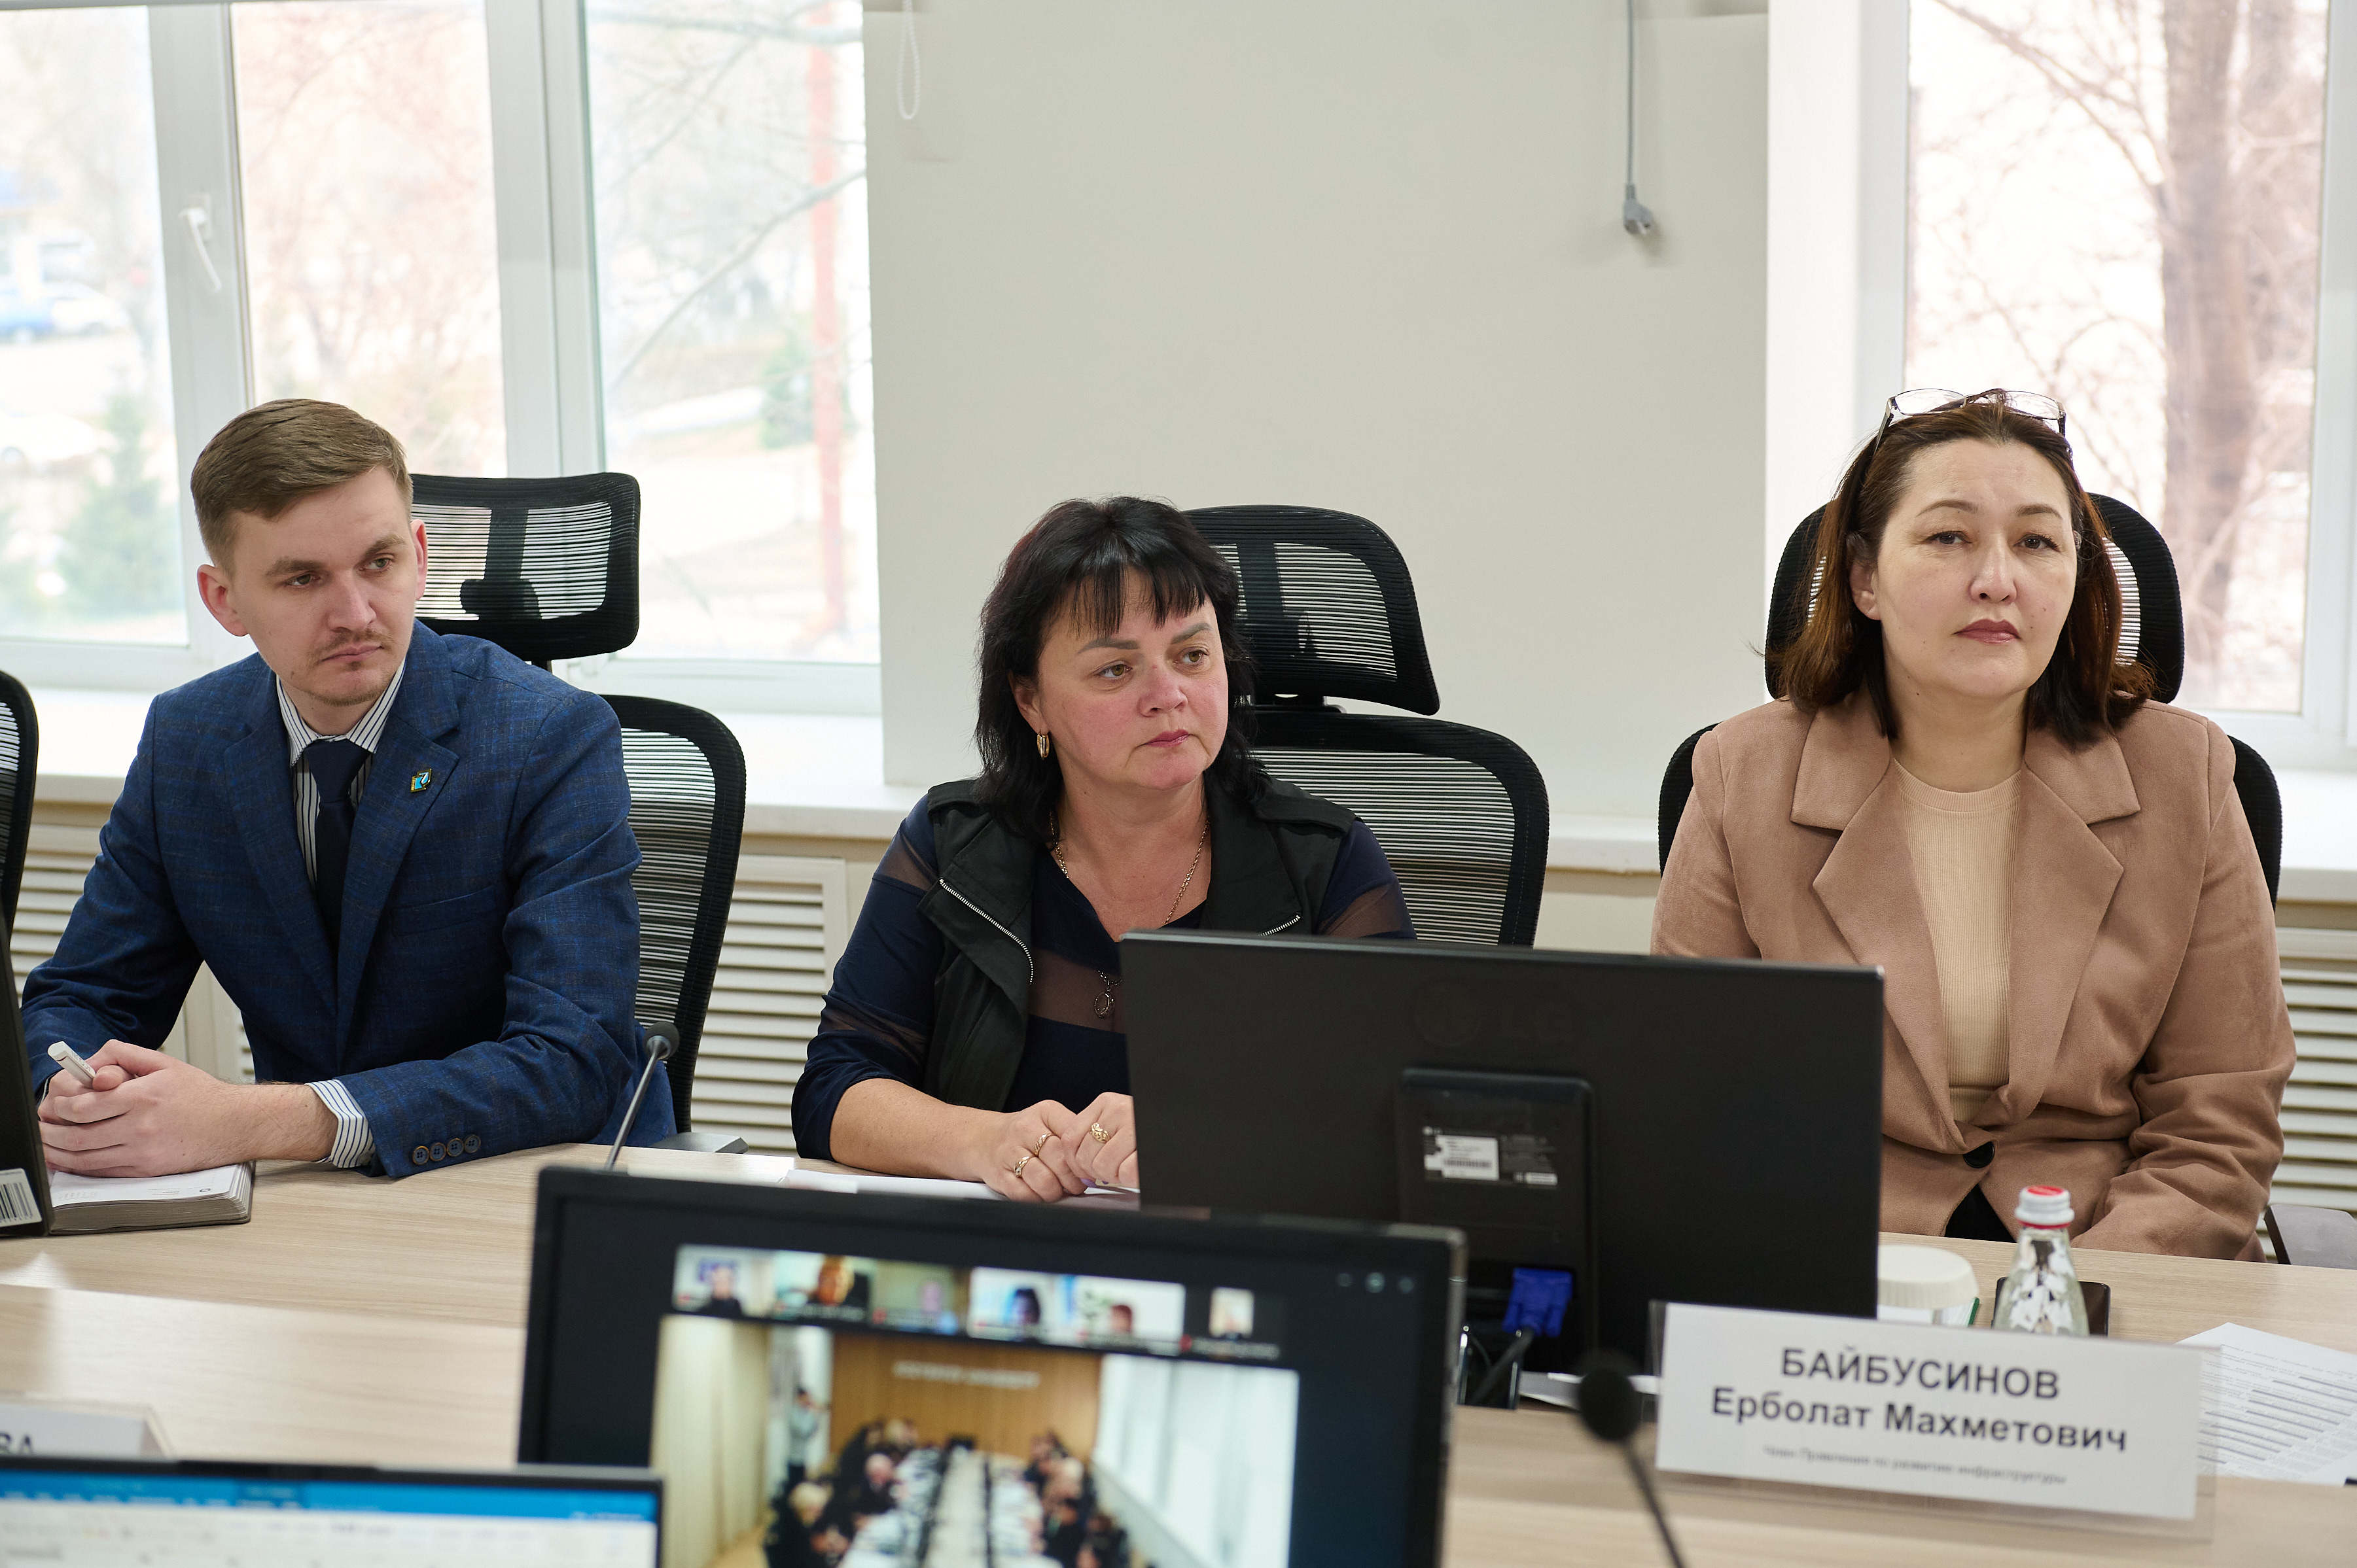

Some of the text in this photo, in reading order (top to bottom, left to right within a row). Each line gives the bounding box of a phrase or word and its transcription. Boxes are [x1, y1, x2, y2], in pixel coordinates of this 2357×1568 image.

[1781, 1346, 2060, 1401] БАЙБУСИНОВ
[1712, 1386, 2127, 1453] Ерболат Махметович
